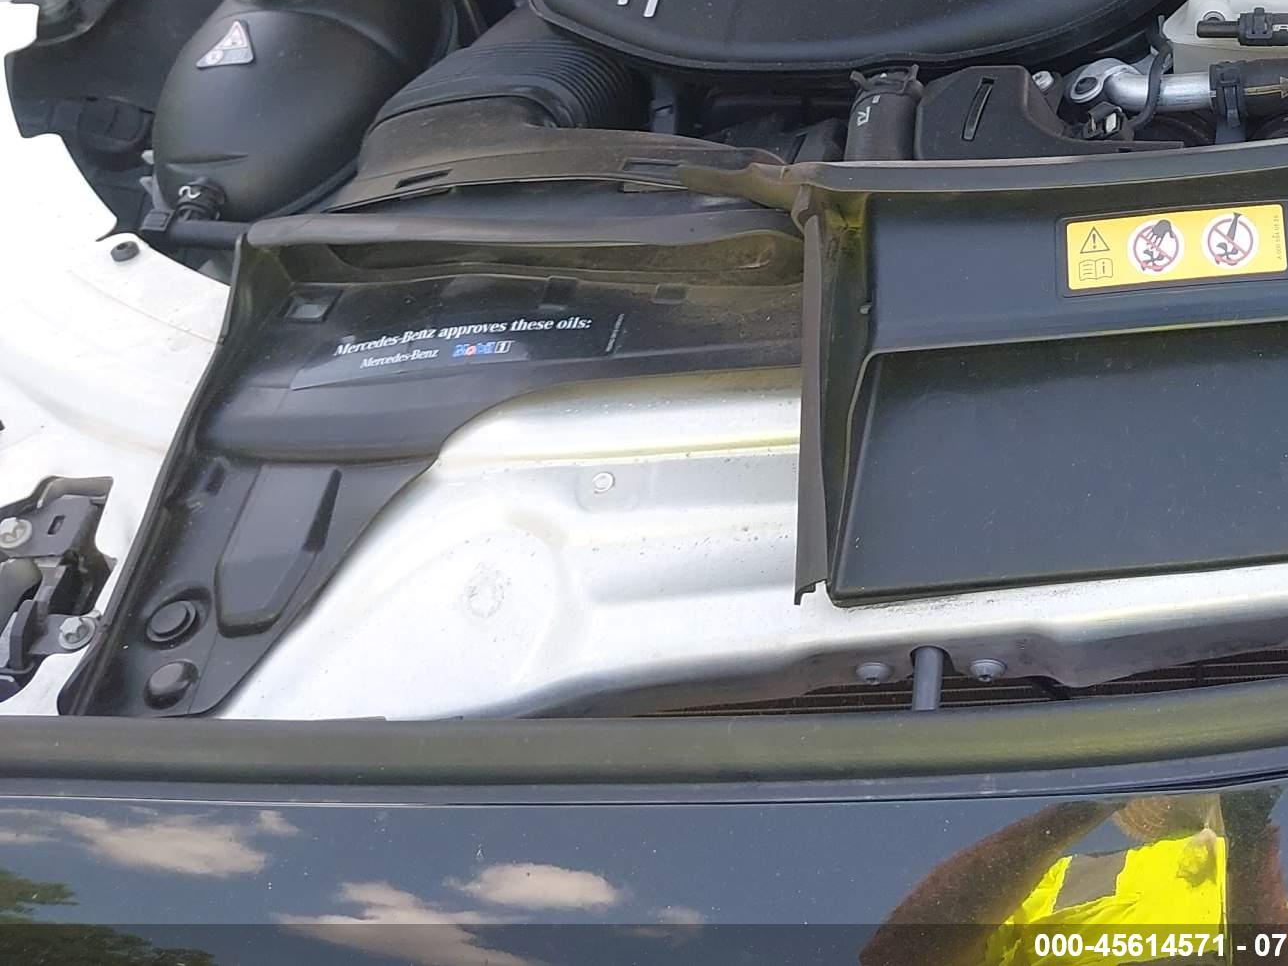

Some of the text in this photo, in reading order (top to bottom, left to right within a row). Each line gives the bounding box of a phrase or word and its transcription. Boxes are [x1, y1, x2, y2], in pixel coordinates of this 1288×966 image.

[334, 317, 593, 356] Mercedes-Benz approves these oils:
[360, 347, 440, 369] Mercedes-Benz
